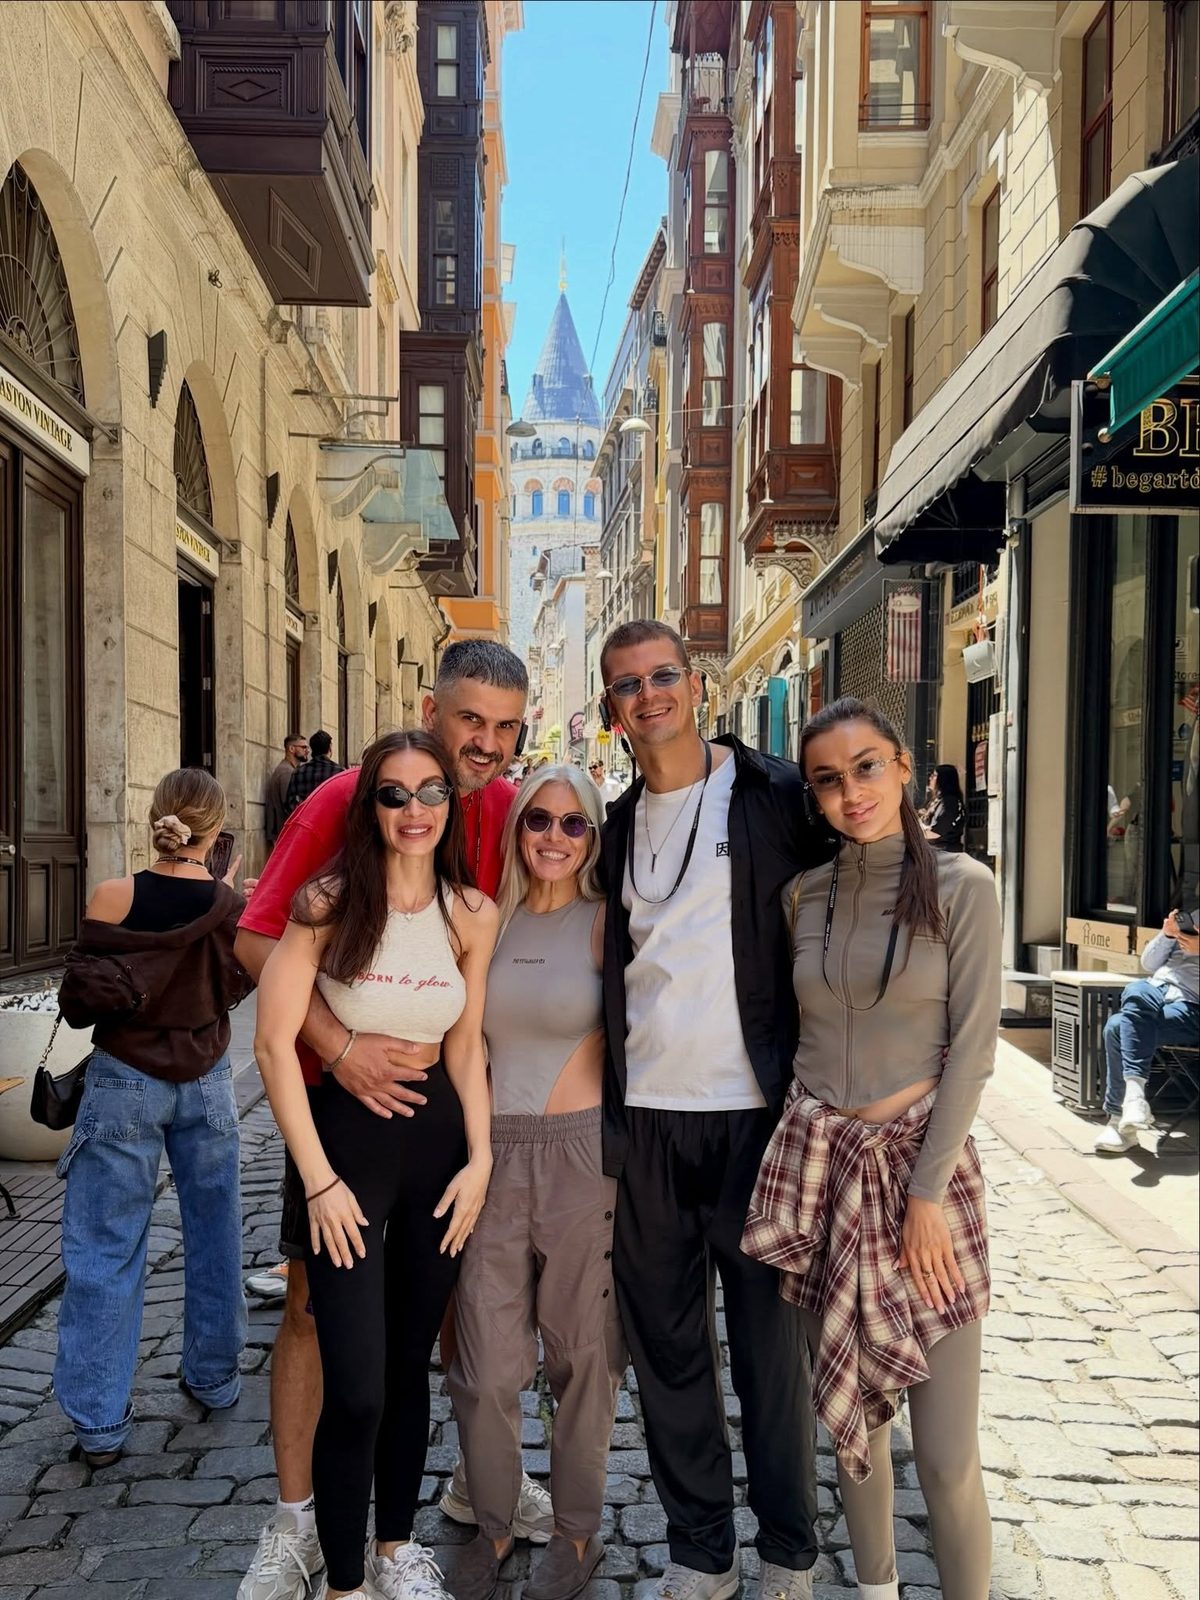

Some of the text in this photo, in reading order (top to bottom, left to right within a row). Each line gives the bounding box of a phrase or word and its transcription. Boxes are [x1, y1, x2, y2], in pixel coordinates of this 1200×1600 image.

[34, 403, 73, 452] VINTAGE
[716, 841, 730, 858] 因
[1082, 922, 1111, 948] Home
[357, 973, 393, 983] BORN
[398, 973, 413, 985] to
